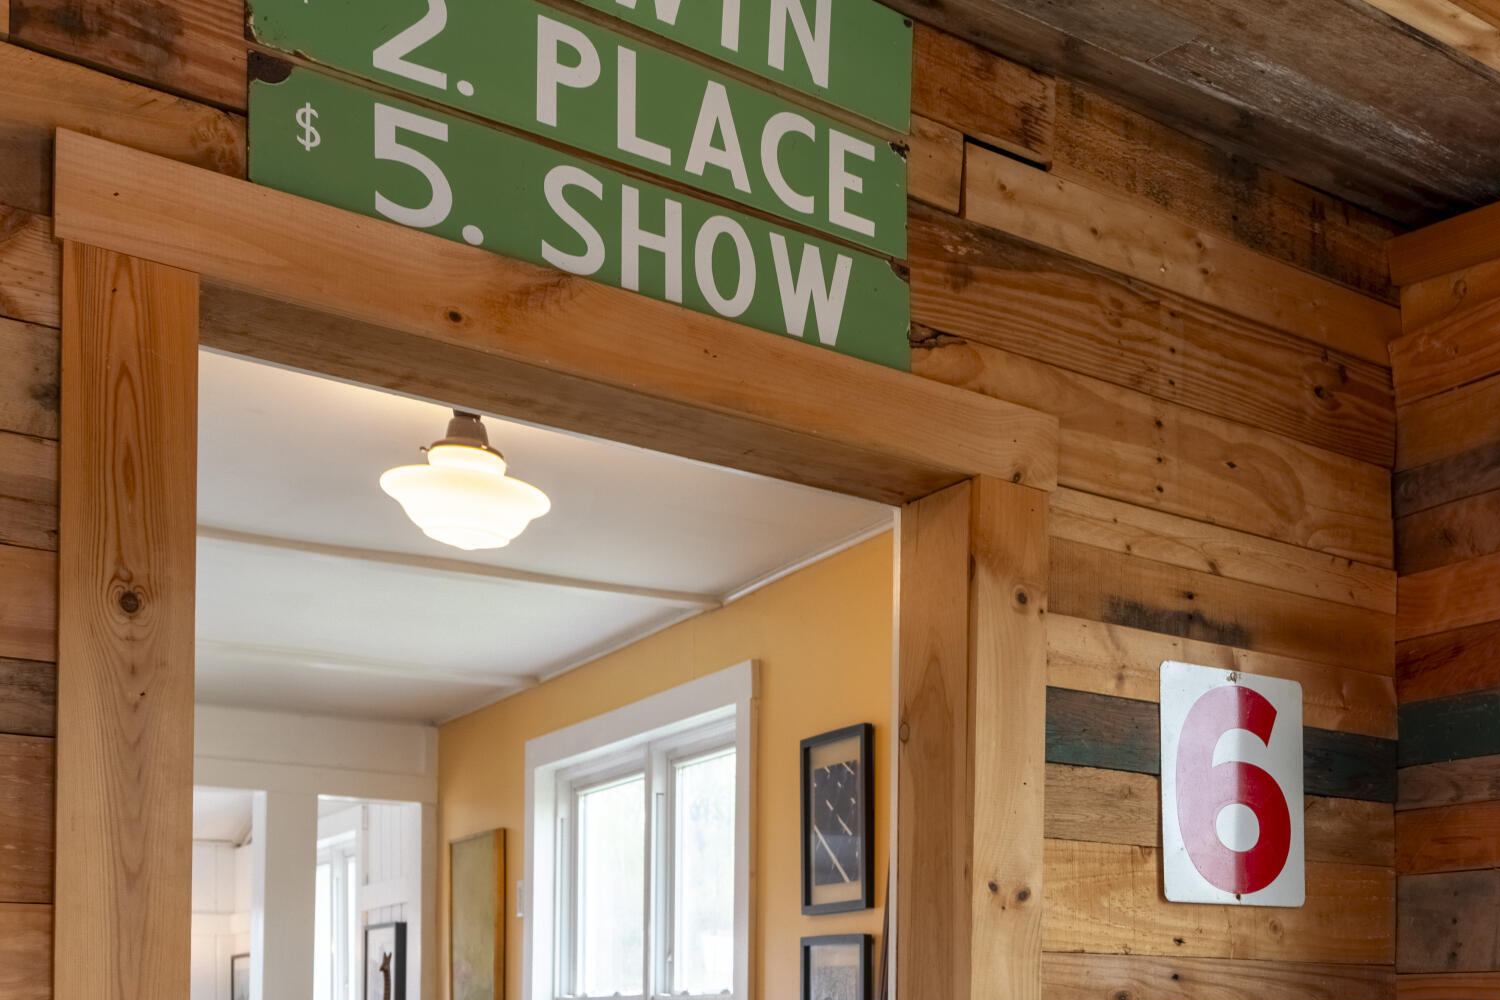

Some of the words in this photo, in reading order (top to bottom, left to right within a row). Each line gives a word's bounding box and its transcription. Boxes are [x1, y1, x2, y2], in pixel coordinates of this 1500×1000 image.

[537, 14, 876, 237] PLACE
[615, 0, 832, 89] IN
[541, 165, 853, 347] SHOW
[1175, 685, 1292, 895] 6
